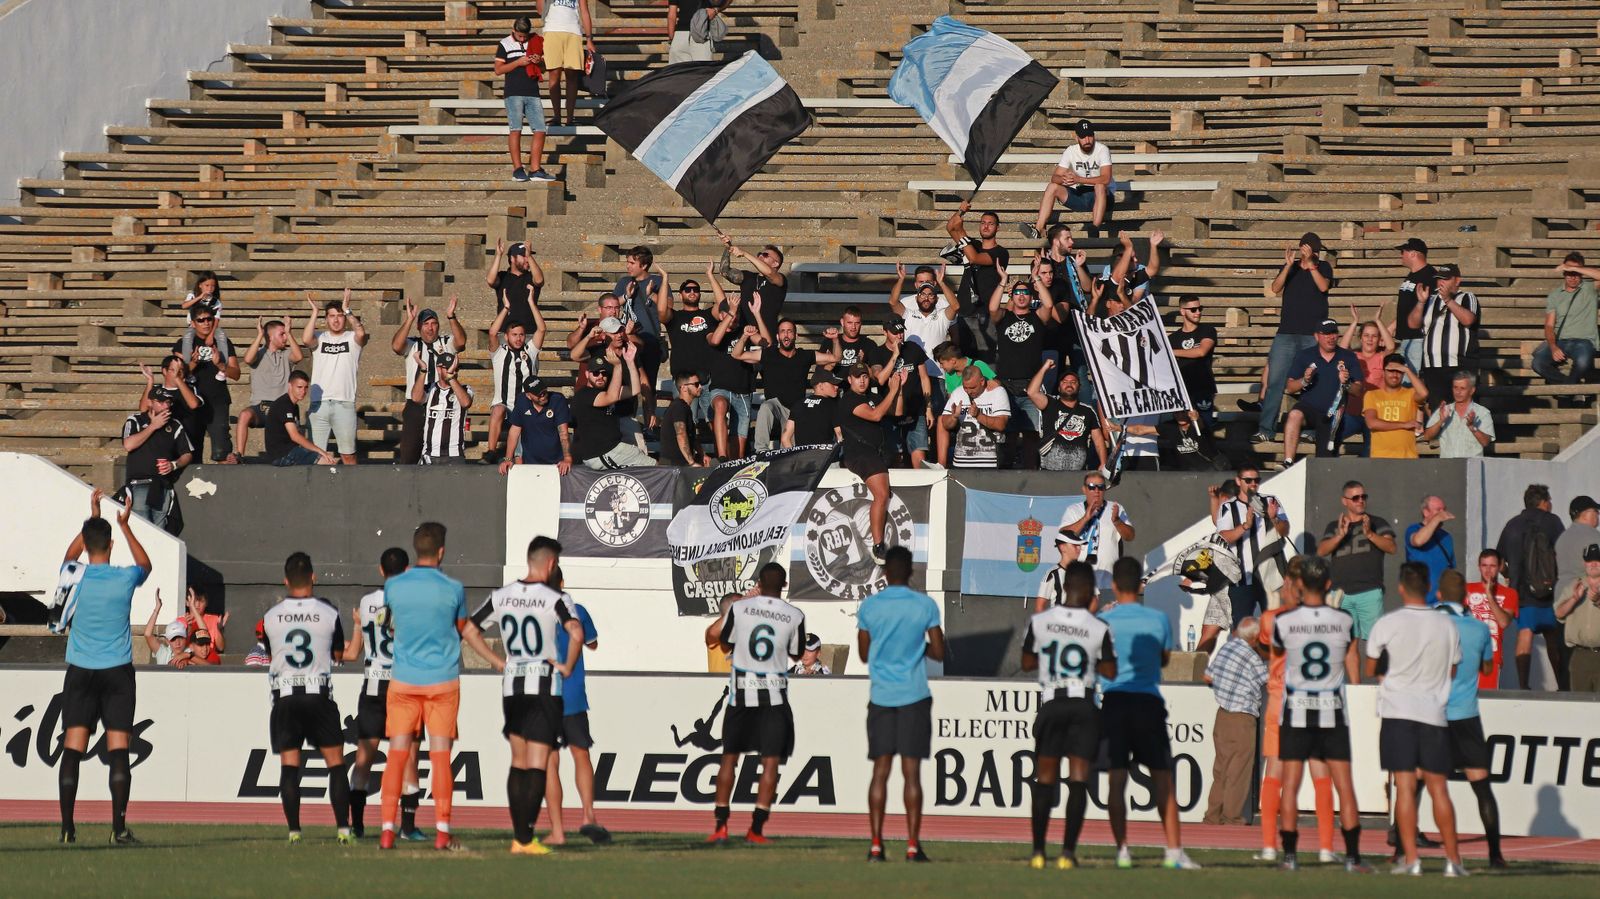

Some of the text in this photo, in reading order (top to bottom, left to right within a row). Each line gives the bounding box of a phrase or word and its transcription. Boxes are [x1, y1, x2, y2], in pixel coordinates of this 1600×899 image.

[1075, 160, 1100, 171] FILA
[1110, 392, 1132, 415] LA
[587, 475, 648, 503] COLECTIVO
[809, 482, 912, 526] SOUH
[824, 526, 851, 551] RBL
[683, 580, 756, 599] CASUALS
[278, 614, 320, 623] TOMAS
[501, 614, 543, 657] 20
[285, 628, 314, 669] 3
[362, 621, 394, 659] 18
[749, 623, 775, 662] 6
[1041, 640, 1089, 681] 19
[1301, 641, 1331, 681] 8
[593, 752, 837, 806] LEGEA
